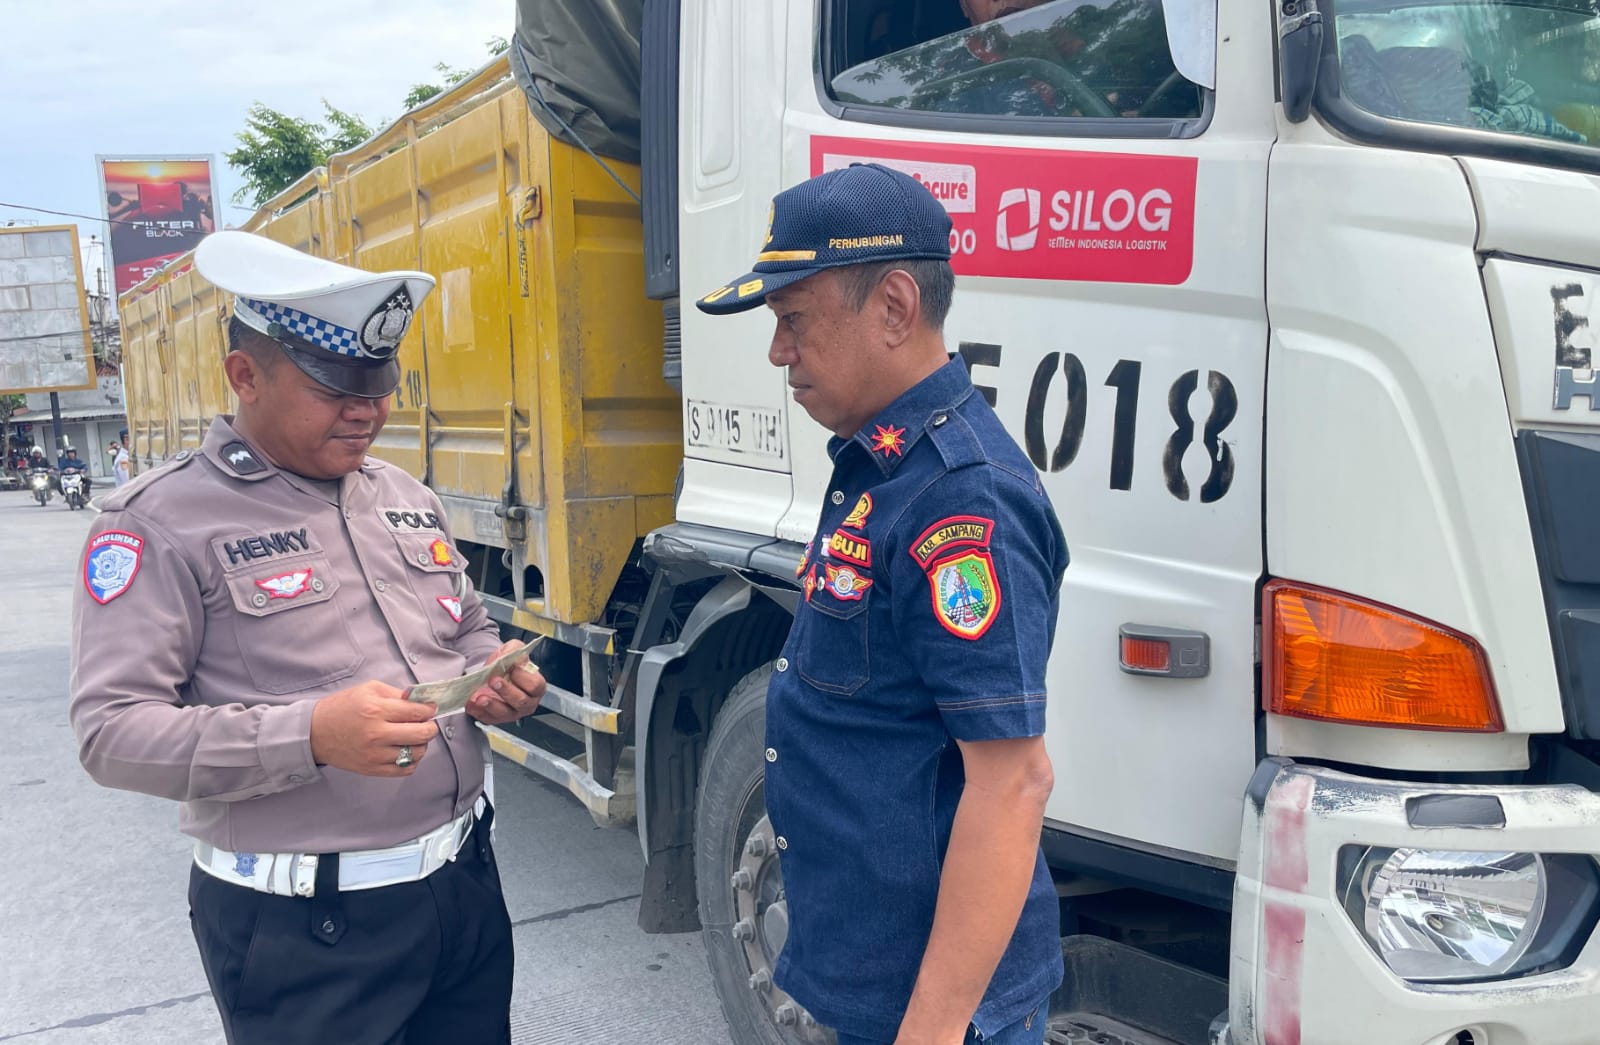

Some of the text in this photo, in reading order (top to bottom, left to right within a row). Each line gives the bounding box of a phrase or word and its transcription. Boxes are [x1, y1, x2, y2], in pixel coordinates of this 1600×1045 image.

[1049, 188, 1173, 232] SILOG
[145, 229, 184, 237] BLACK
[828, 234, 903, 249] PERHUBUNGAN
[1077, 239, 1122, 249] INDONESIA
[1125, 240, 1167, 250] LOGISTIK
[691, 406, 700, 441] S
[385, 510, 444, 532] POLR
[939, 524, 984, 542] SAMPANG
[223, 528, 310, 564] HENKY
